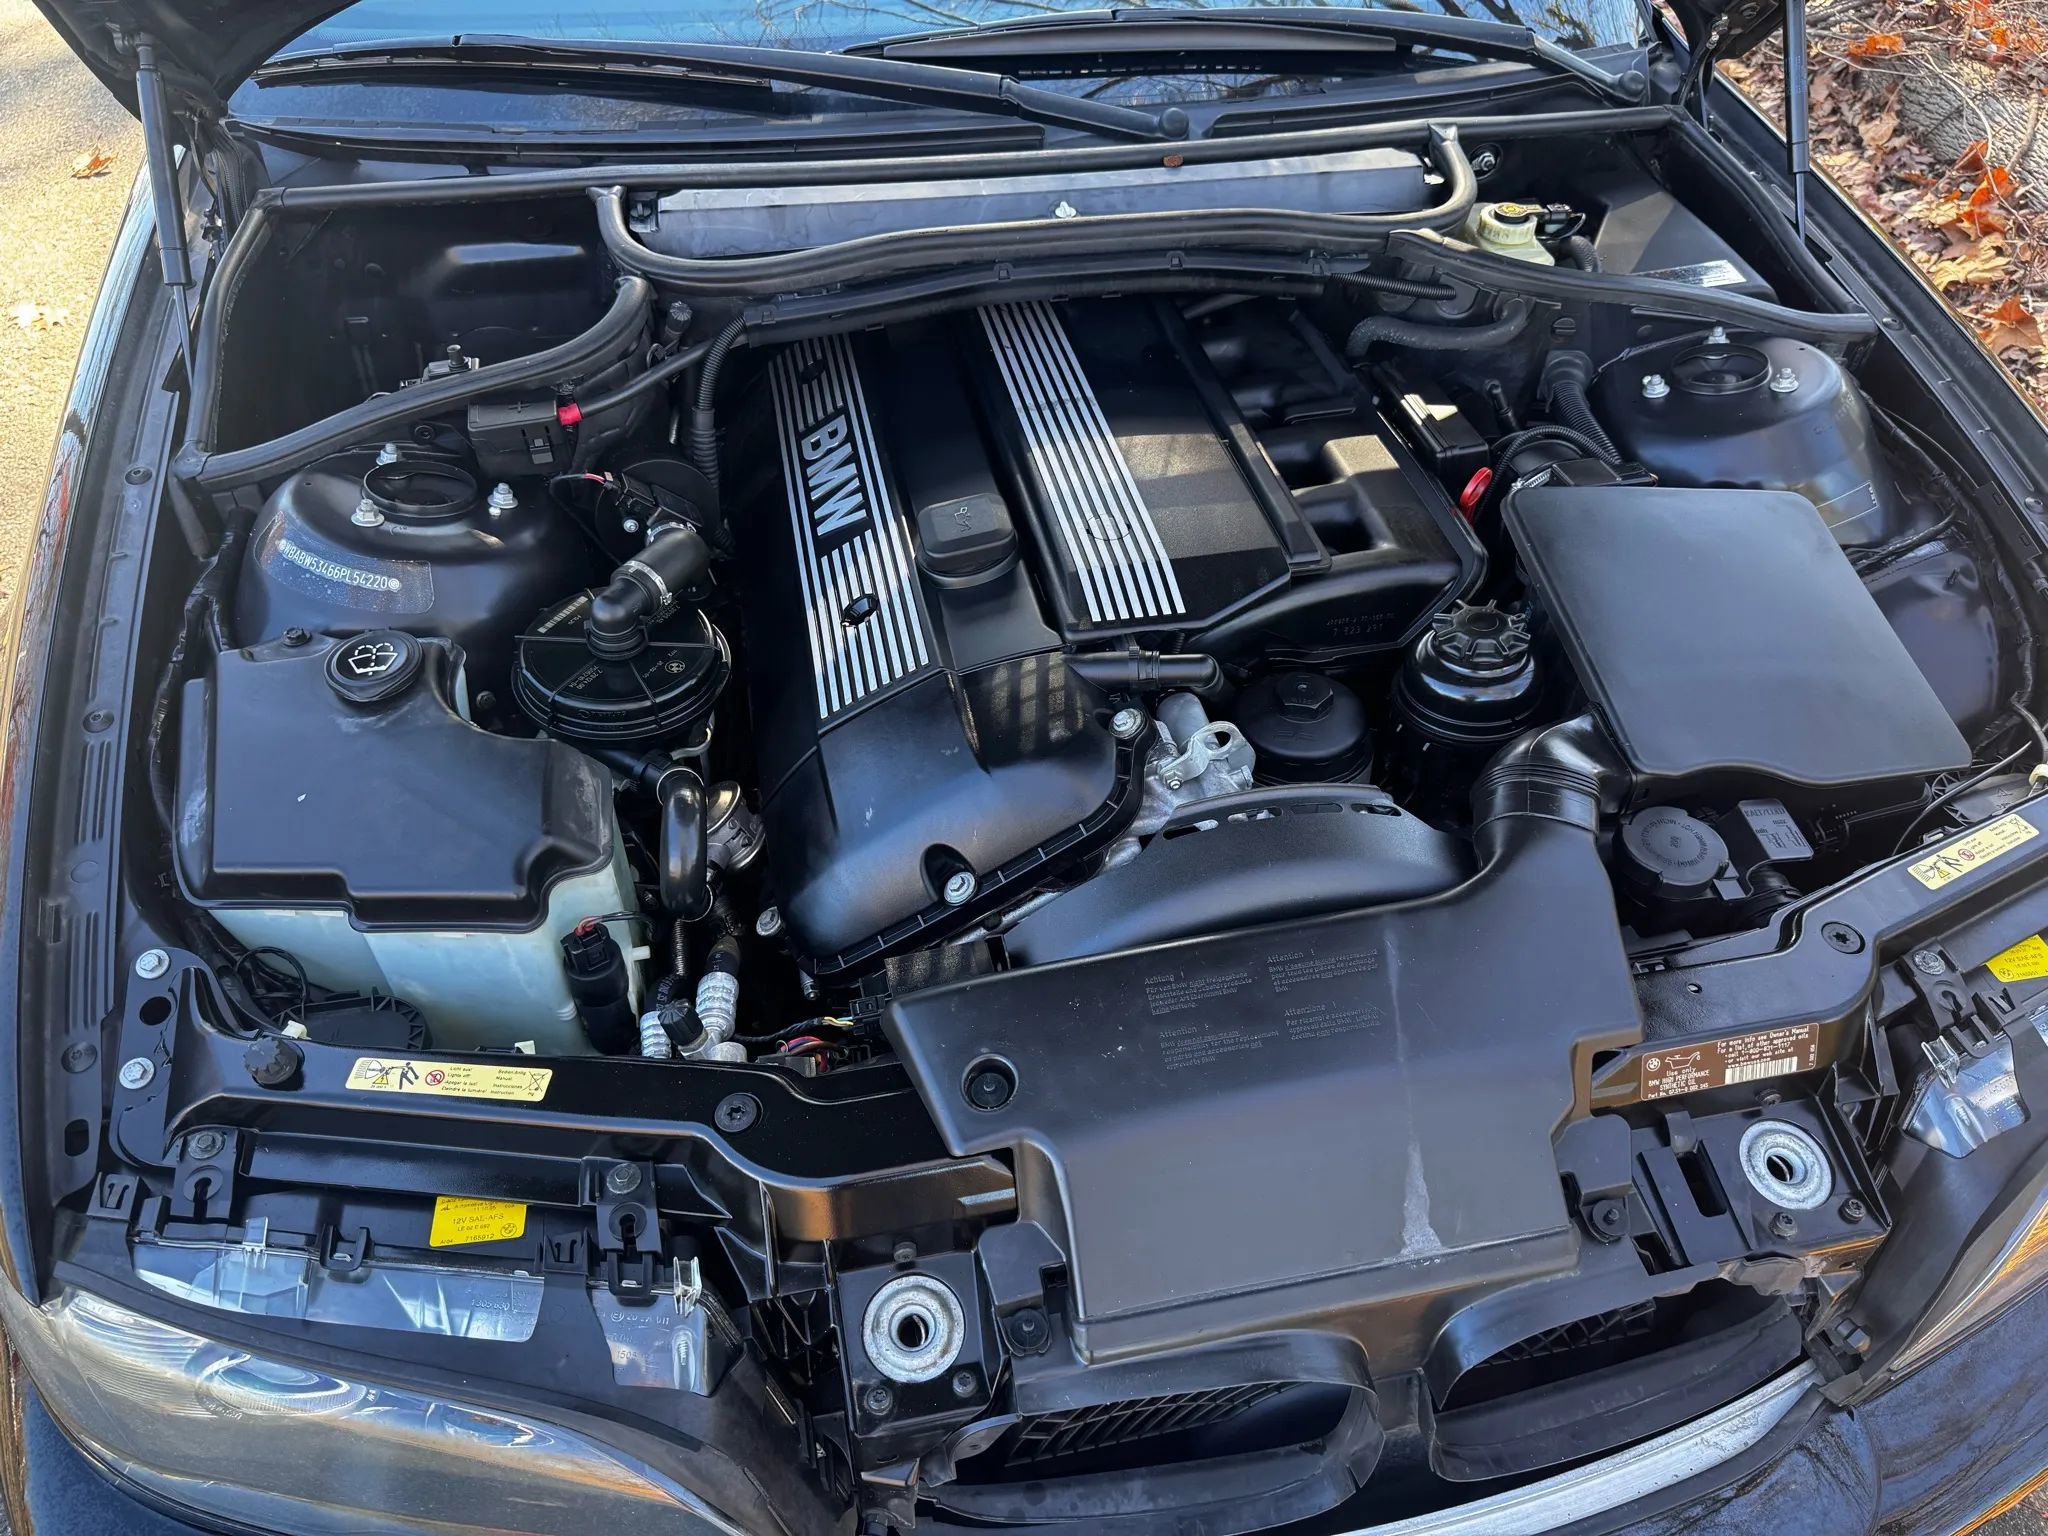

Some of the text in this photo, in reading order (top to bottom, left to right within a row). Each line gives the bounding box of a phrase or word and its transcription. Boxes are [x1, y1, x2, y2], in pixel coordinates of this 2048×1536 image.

[801, 414, 867, 536] BMW
[1266, 951, 1304, 964] Attention
[1144, 974, 1174, 984] Achtung
[1160, 1026, 1197, 1038] Attention
[1792, 1026, 1809, 1034] Manual
